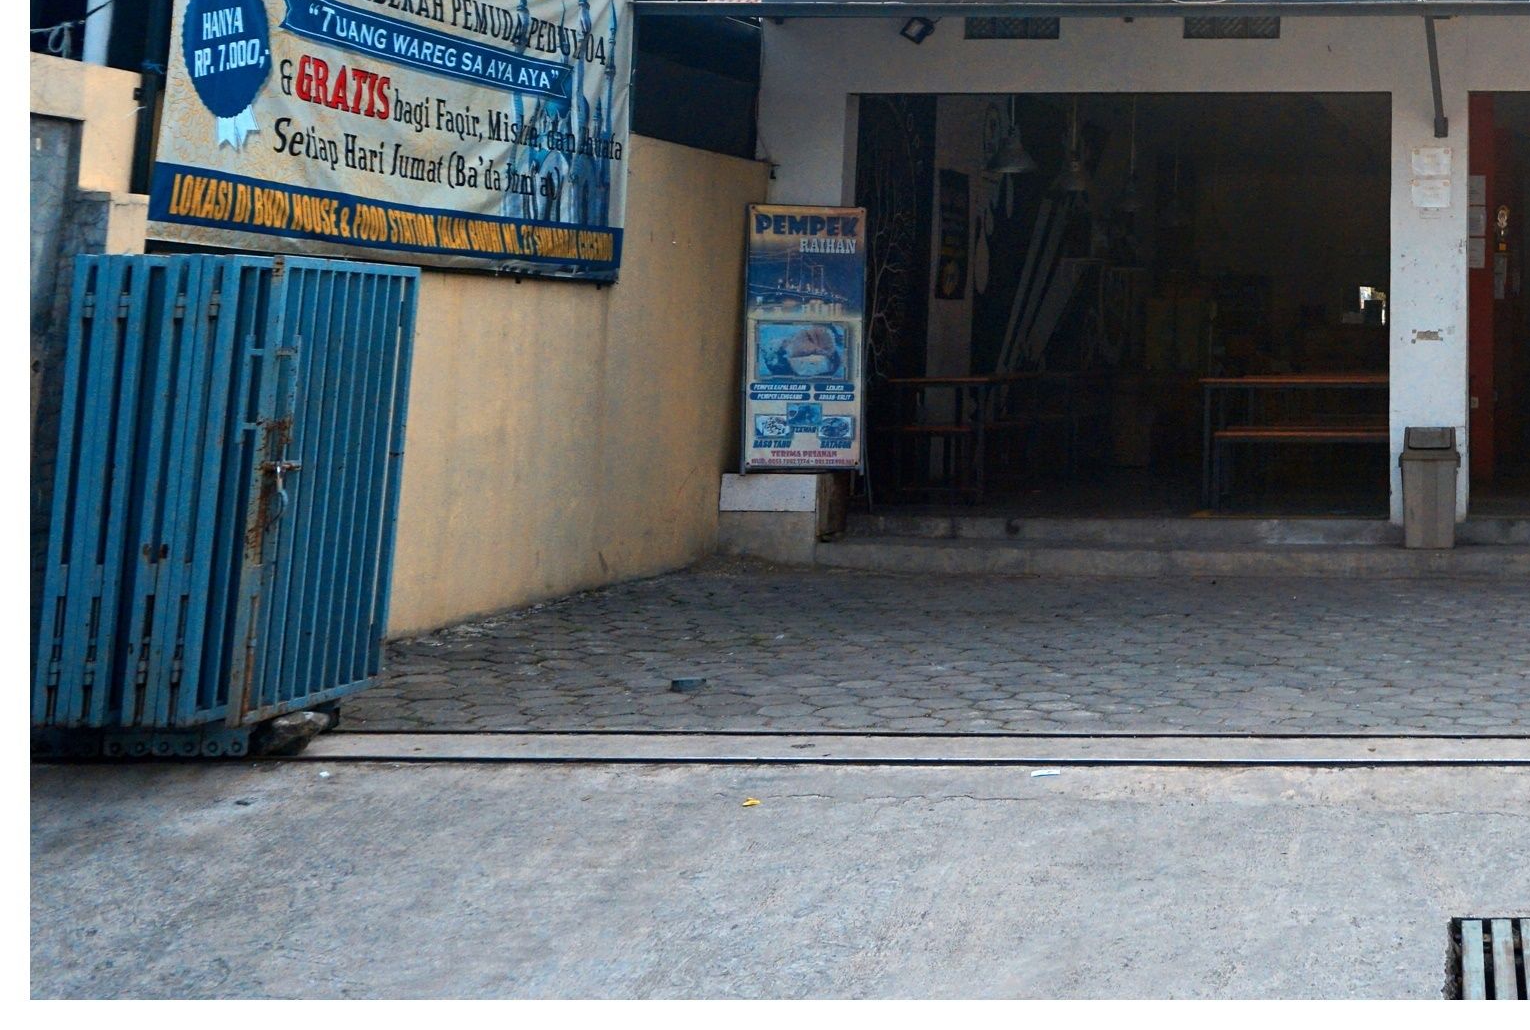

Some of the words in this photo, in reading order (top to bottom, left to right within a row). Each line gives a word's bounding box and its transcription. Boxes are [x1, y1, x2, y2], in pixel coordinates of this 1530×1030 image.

[202, 6, 244, 40] HANYA
[526, 17, 587, 60] PEDUL
[586, 33, 606, 66] 04
[194, 47, 214, 78] RP.
[393, 33, 457, 68] WAREG
[461, 51, 482, 76] SA
[485, 59, 513, 83] AYA
[280, 59, 293, 96] &
[295, 54, 391, 120] GRATIS
[393, 88, 430, 133] bagi
[436, 98, 483, 143] Faqir,
[273, 117, 338, 171] Setiap
[343, 132, 385, 174] Hari
[390, 142, 443, 183] Jumat
[169, 173, 233, 220] LOKASI
[233, 183, 251, 224] DI
[253, 187, 290, 229] BUDI
[291, 193, 339, 237] HOUSE
[340, 206, 351, 238] &
[352, 203, 388, 242] FOOD
[388, 208, 437, 248] STATION
[755, 213, 860, 237] PEMPEK
[800, 237, 857, 254] RAIHAN
